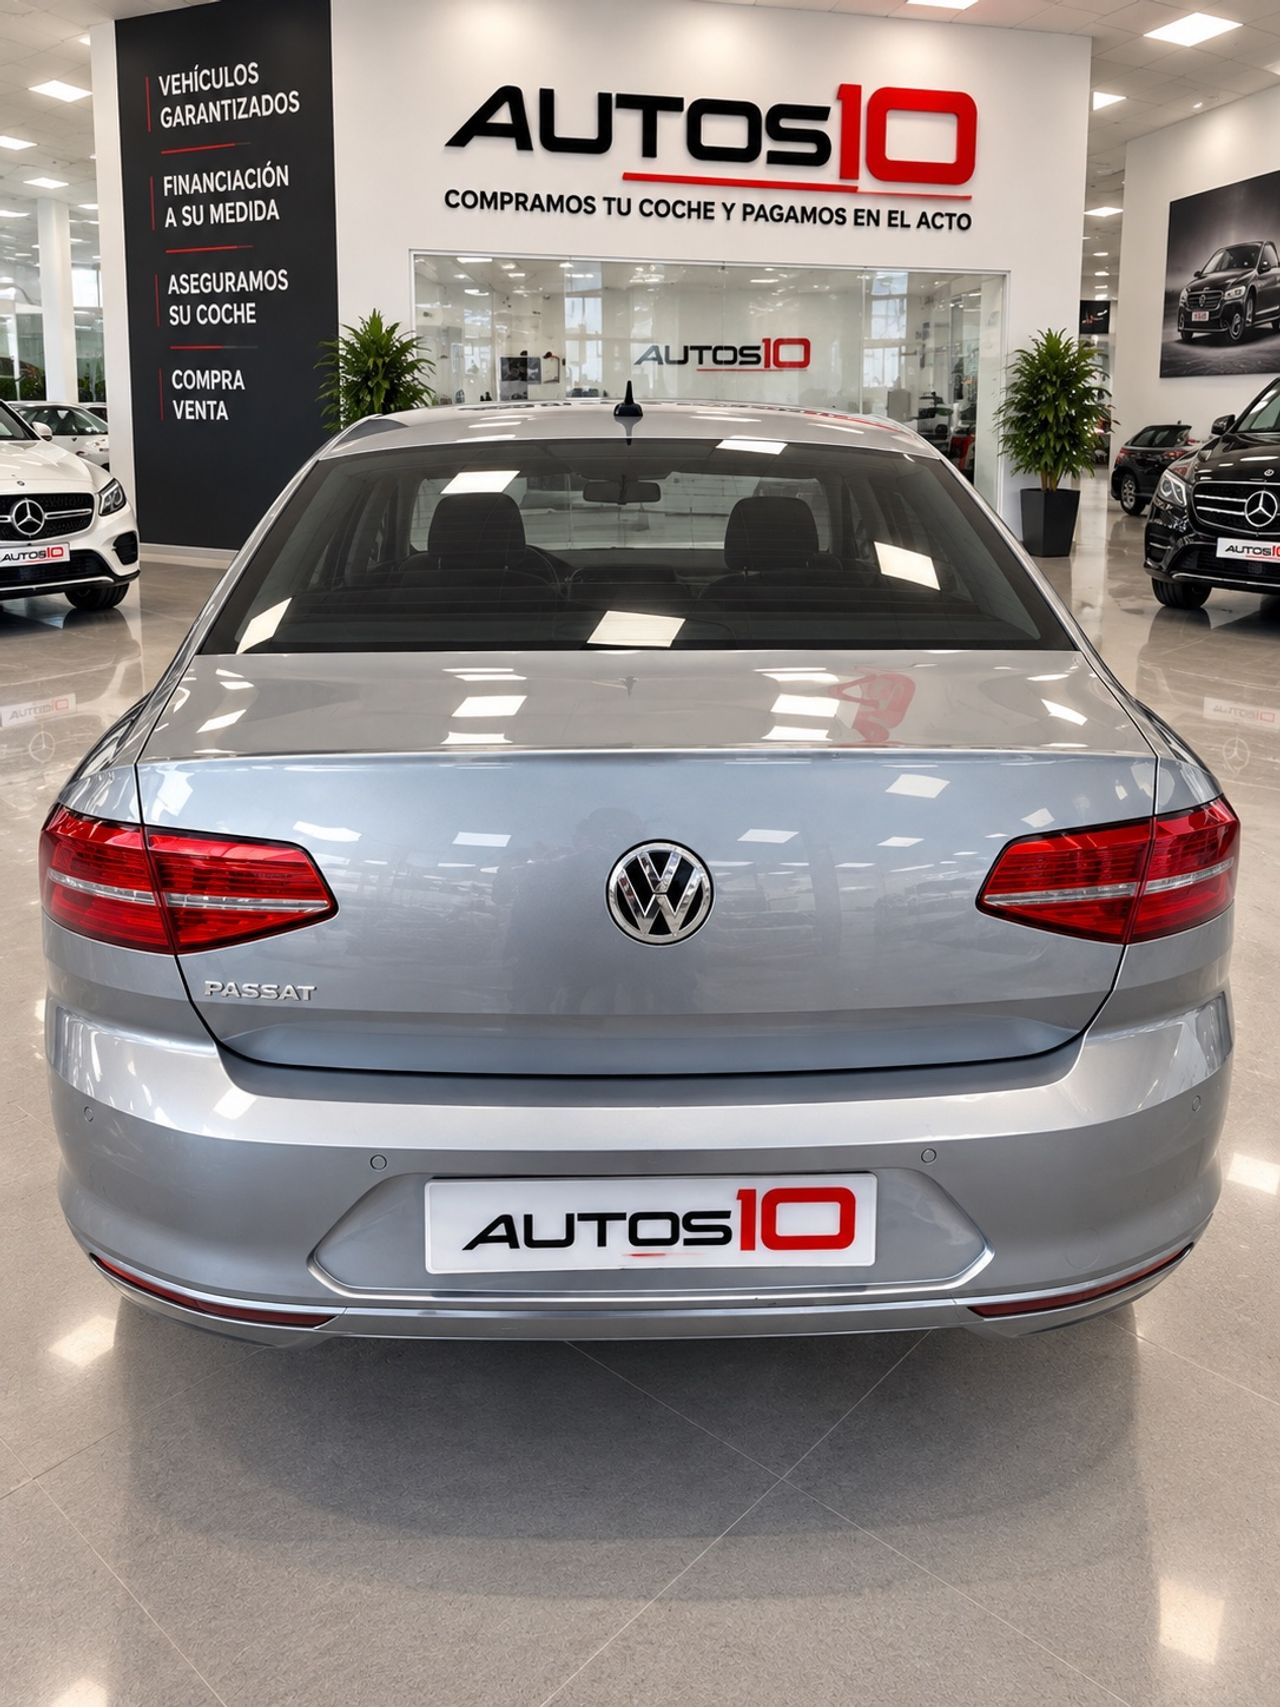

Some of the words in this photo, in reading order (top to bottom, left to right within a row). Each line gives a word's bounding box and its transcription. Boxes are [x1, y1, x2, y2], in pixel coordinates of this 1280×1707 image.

[158, 62, 260, 96] VEHÍCULOS
[160, 90, 300, 129] GARANTIZADOS
[444, 83, 978, 186] AUTOS10
[163, 160, 289, 197] FINANCIACIÓN
[164, 207, 178, 228] A
[181, 204, 204, 227] SU
[209, 199, 280, 225] MEDIDA
[444, 189, 597, 215] COMPRAMOS
[602, 196, 632, 216] TU
[638, 198, 716, 220] COCHE
[721, 202, 736, 221] Y
[741, 203, 847, 226] PAGAMOS
[853, 208, 881, 227] EN
[887, 209, 911, 228] EL
[916, 211, 973, 231] ACTO
[167, 269, 289, 295] ASEGURAMOS
[169, 304, 191, 326] SU
[196, 302, 257, 325] COCHE
[633, 337, 811, 369] AUTOS10
[171, 369, 246, 390] COMPRA
[172, 400, 229, 421] VENTA
[204, 980, 317, 1001] PASSAT
[461, 1186, 857, 1252] AUTOS10
